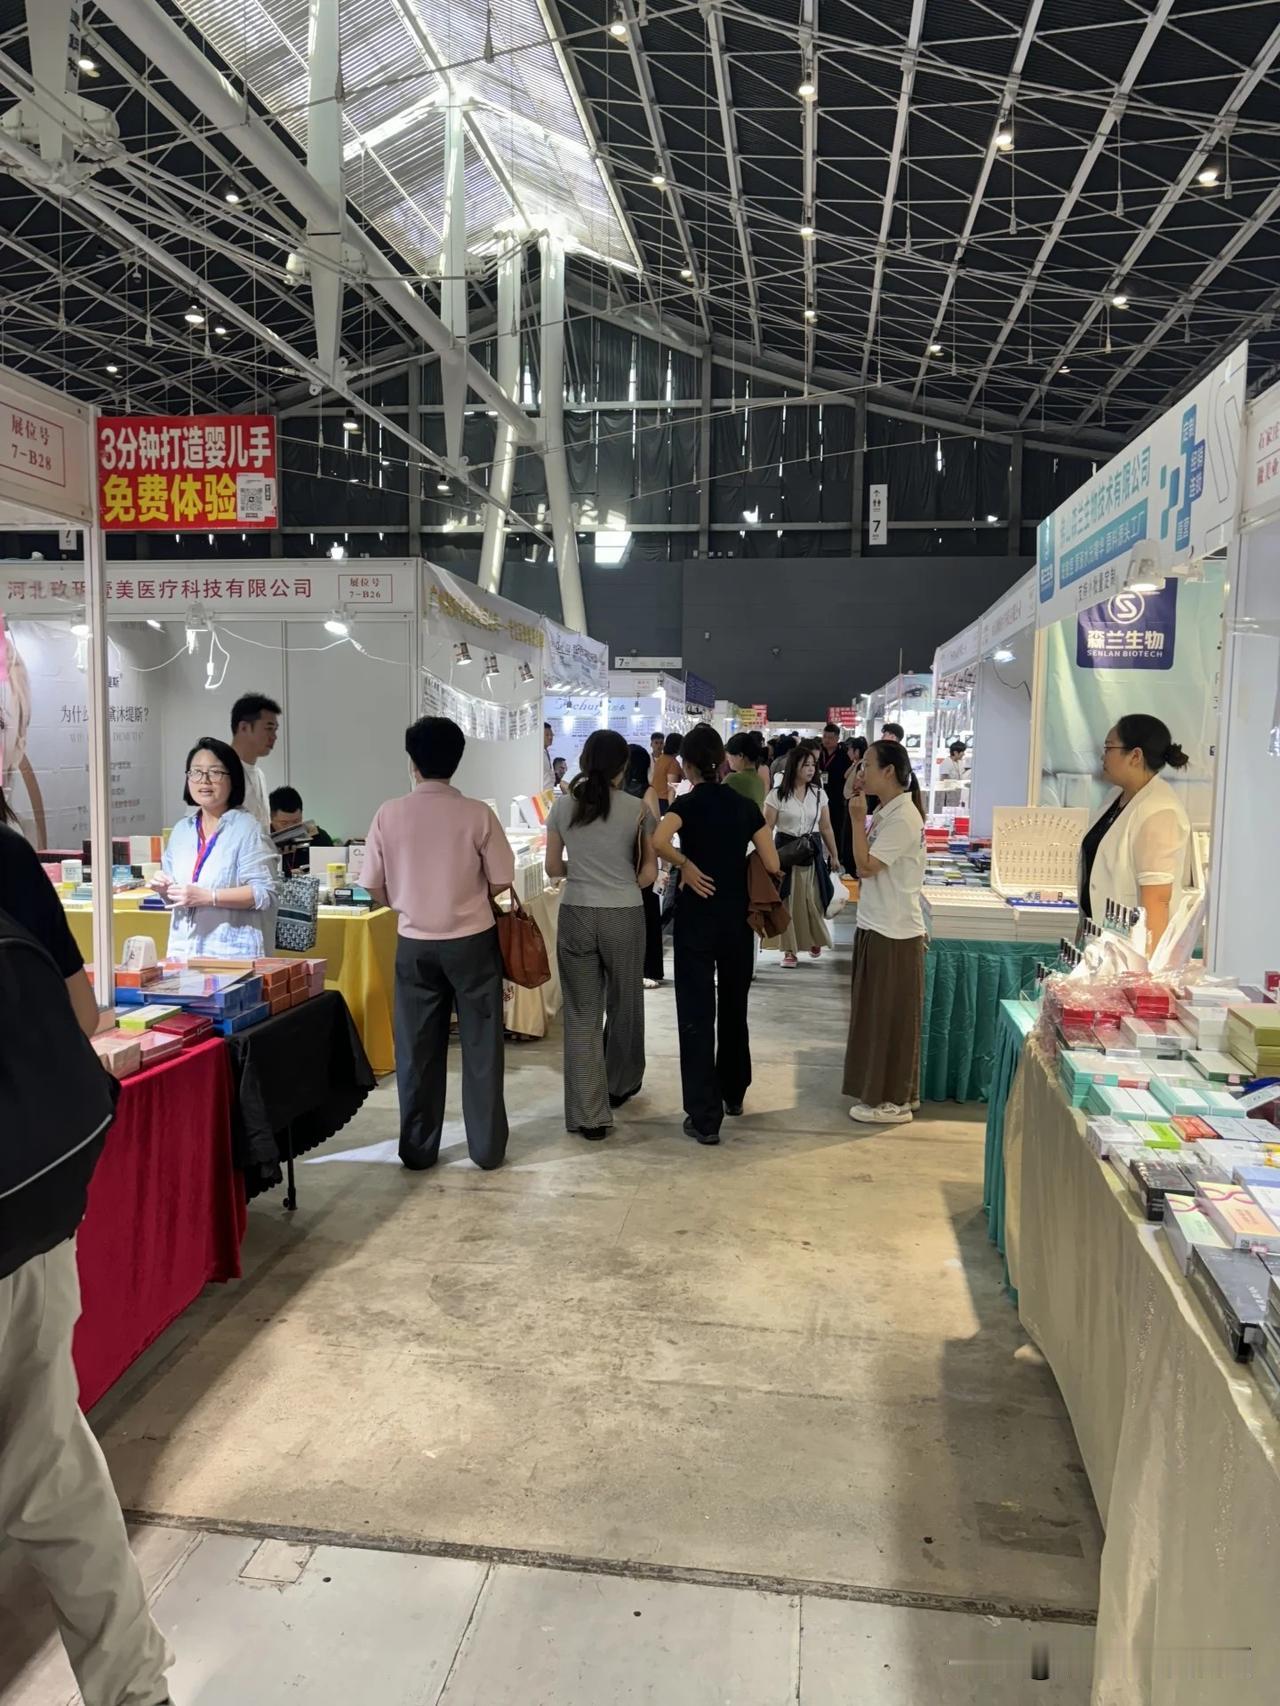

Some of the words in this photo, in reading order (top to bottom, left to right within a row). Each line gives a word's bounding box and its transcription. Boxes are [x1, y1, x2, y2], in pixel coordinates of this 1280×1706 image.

[11, 415, 51, 446] 展位号
[101, 425, 271, 470] 3分钟打造婴儿手
[11, 444, 52, 471] 7-B28
[103, 473, 237, 523] 免费体验
[872, 520, 881, 533] 7
[350, 577, 380, 588] 展位号
[349, 590, 381, 599] 7-B26
[1087, 630, 1165, 650] 森兰生物
[1087, 649, 1121, 658] SENLAN
[1122, 650, 1163, 658] BIOTECH
[618, 658, 625, 667] 7
